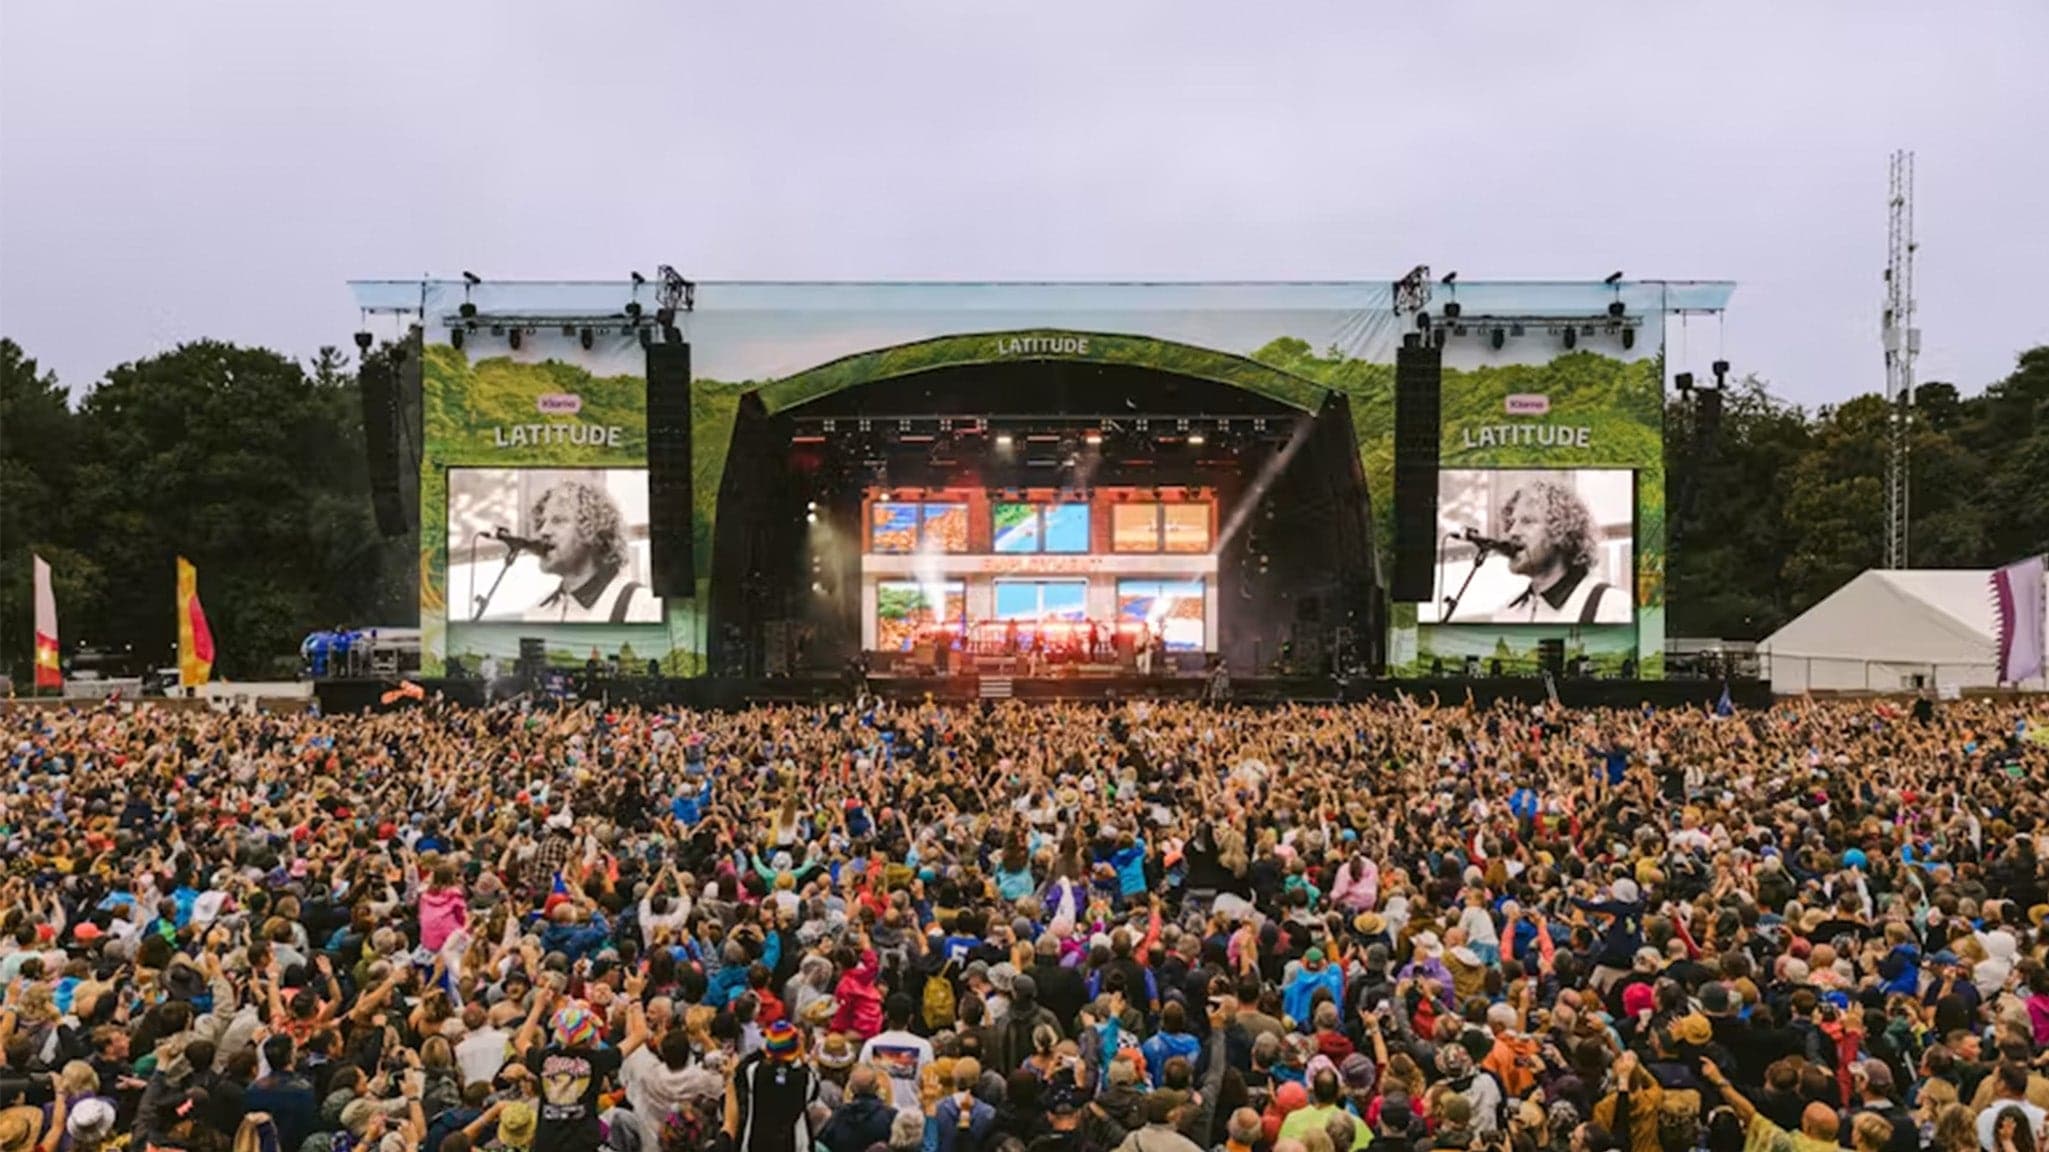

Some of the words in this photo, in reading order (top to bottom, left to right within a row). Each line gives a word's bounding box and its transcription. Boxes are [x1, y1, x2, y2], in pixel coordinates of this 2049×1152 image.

[998, 338, 1089, 354] LATITUDE
[495, 424, 623, 448] LATITUDE
[1463, 424, 1592, 448] LATITUDE
